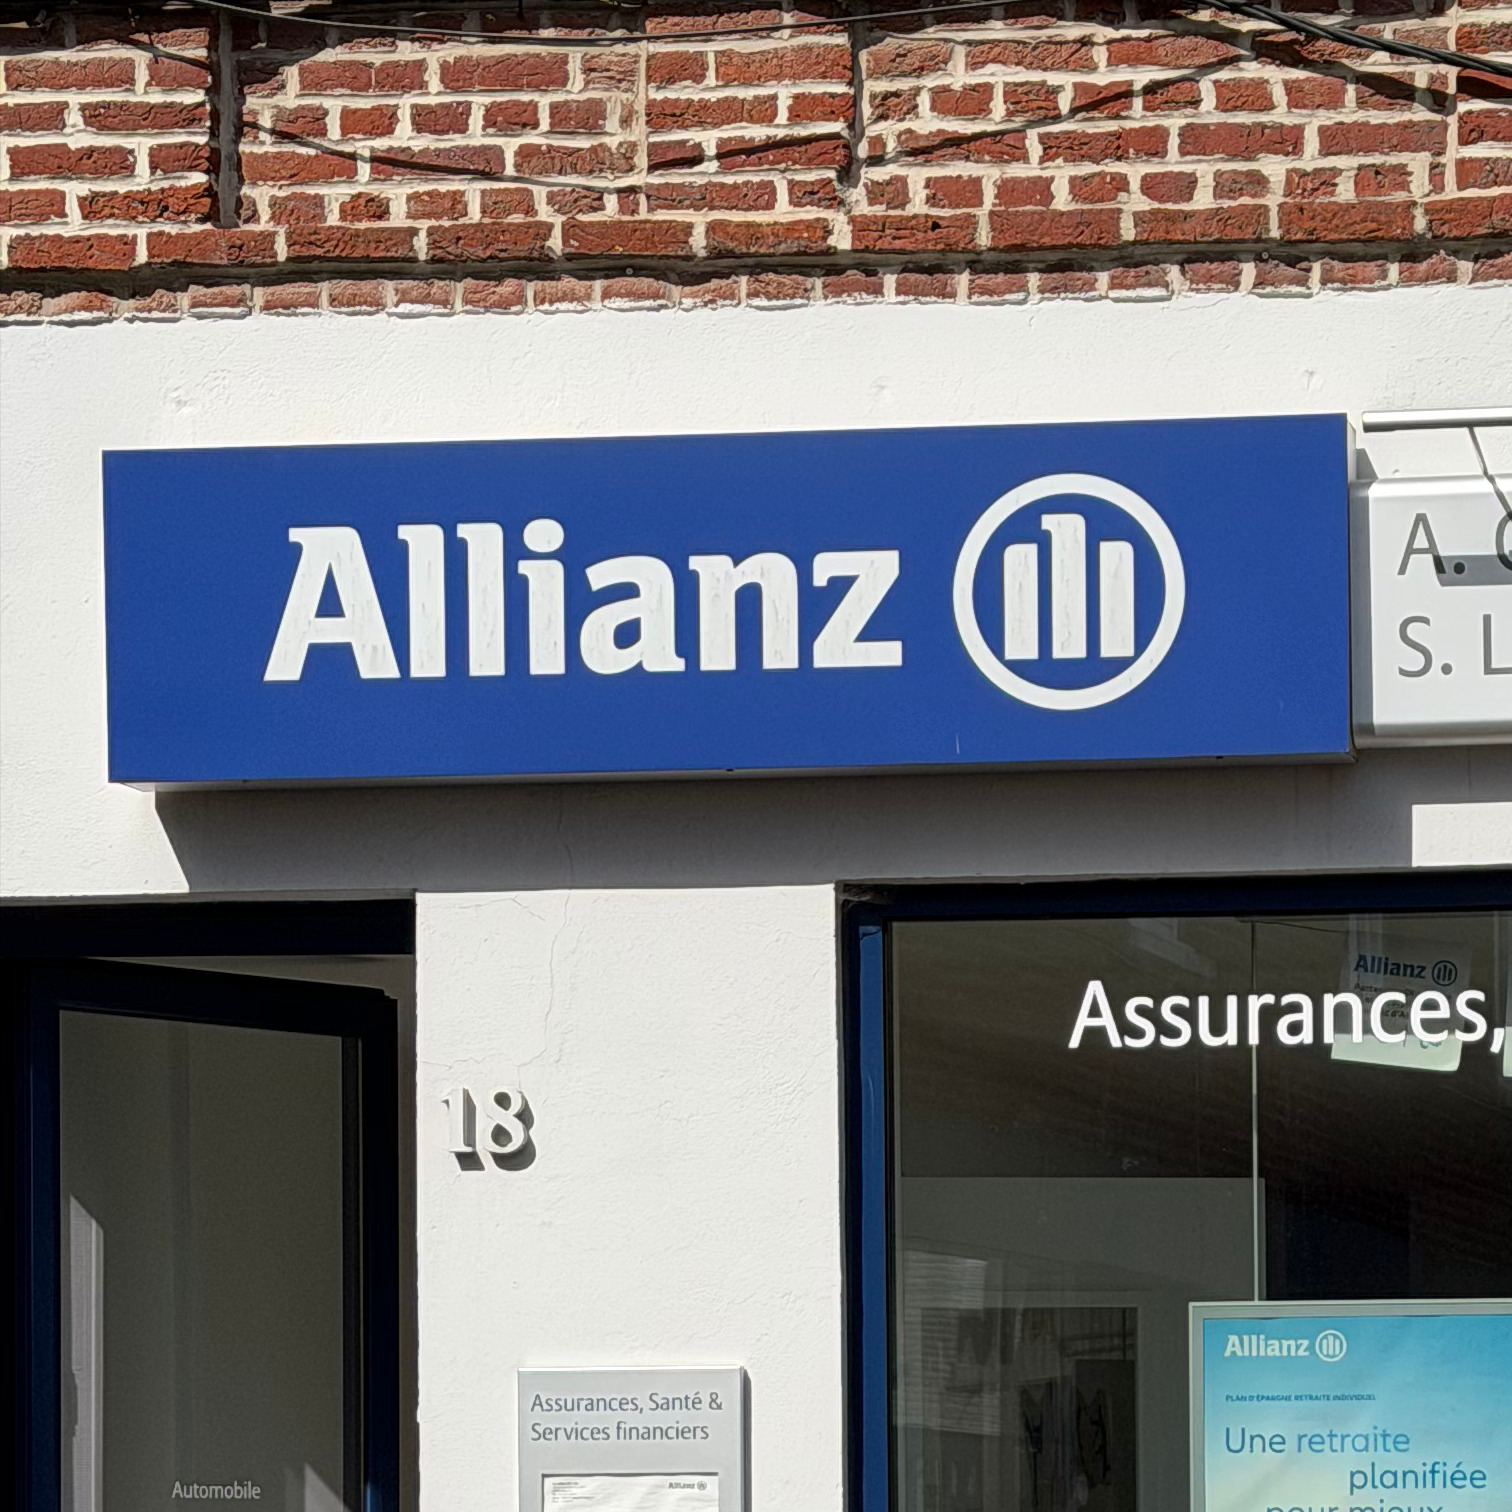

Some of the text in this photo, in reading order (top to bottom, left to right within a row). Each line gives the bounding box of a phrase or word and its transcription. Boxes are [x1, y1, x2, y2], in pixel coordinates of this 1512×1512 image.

[1397, 512, 1466, 577] A.
[262, 517, 904, 683] Allianz
[1398, 615, 1454, 678] S.
[1354, 953, 1427, 979] Allianz
[1069, 979, 1506, 1053] Assurances,
[443, 1086, 530, 1160] 18
[1224, 1335, 1309, 1358] Allianz
[531, 1391, 723, 1414] Assurances, Santé &
[531, 1420, 710, 1442] Services financiers
[1225, 1425, 1410, 1453] Une retraite
[172, 1481, 261, 1500] Automobile
[1349, 1461, 1487, 1495] planifiée
